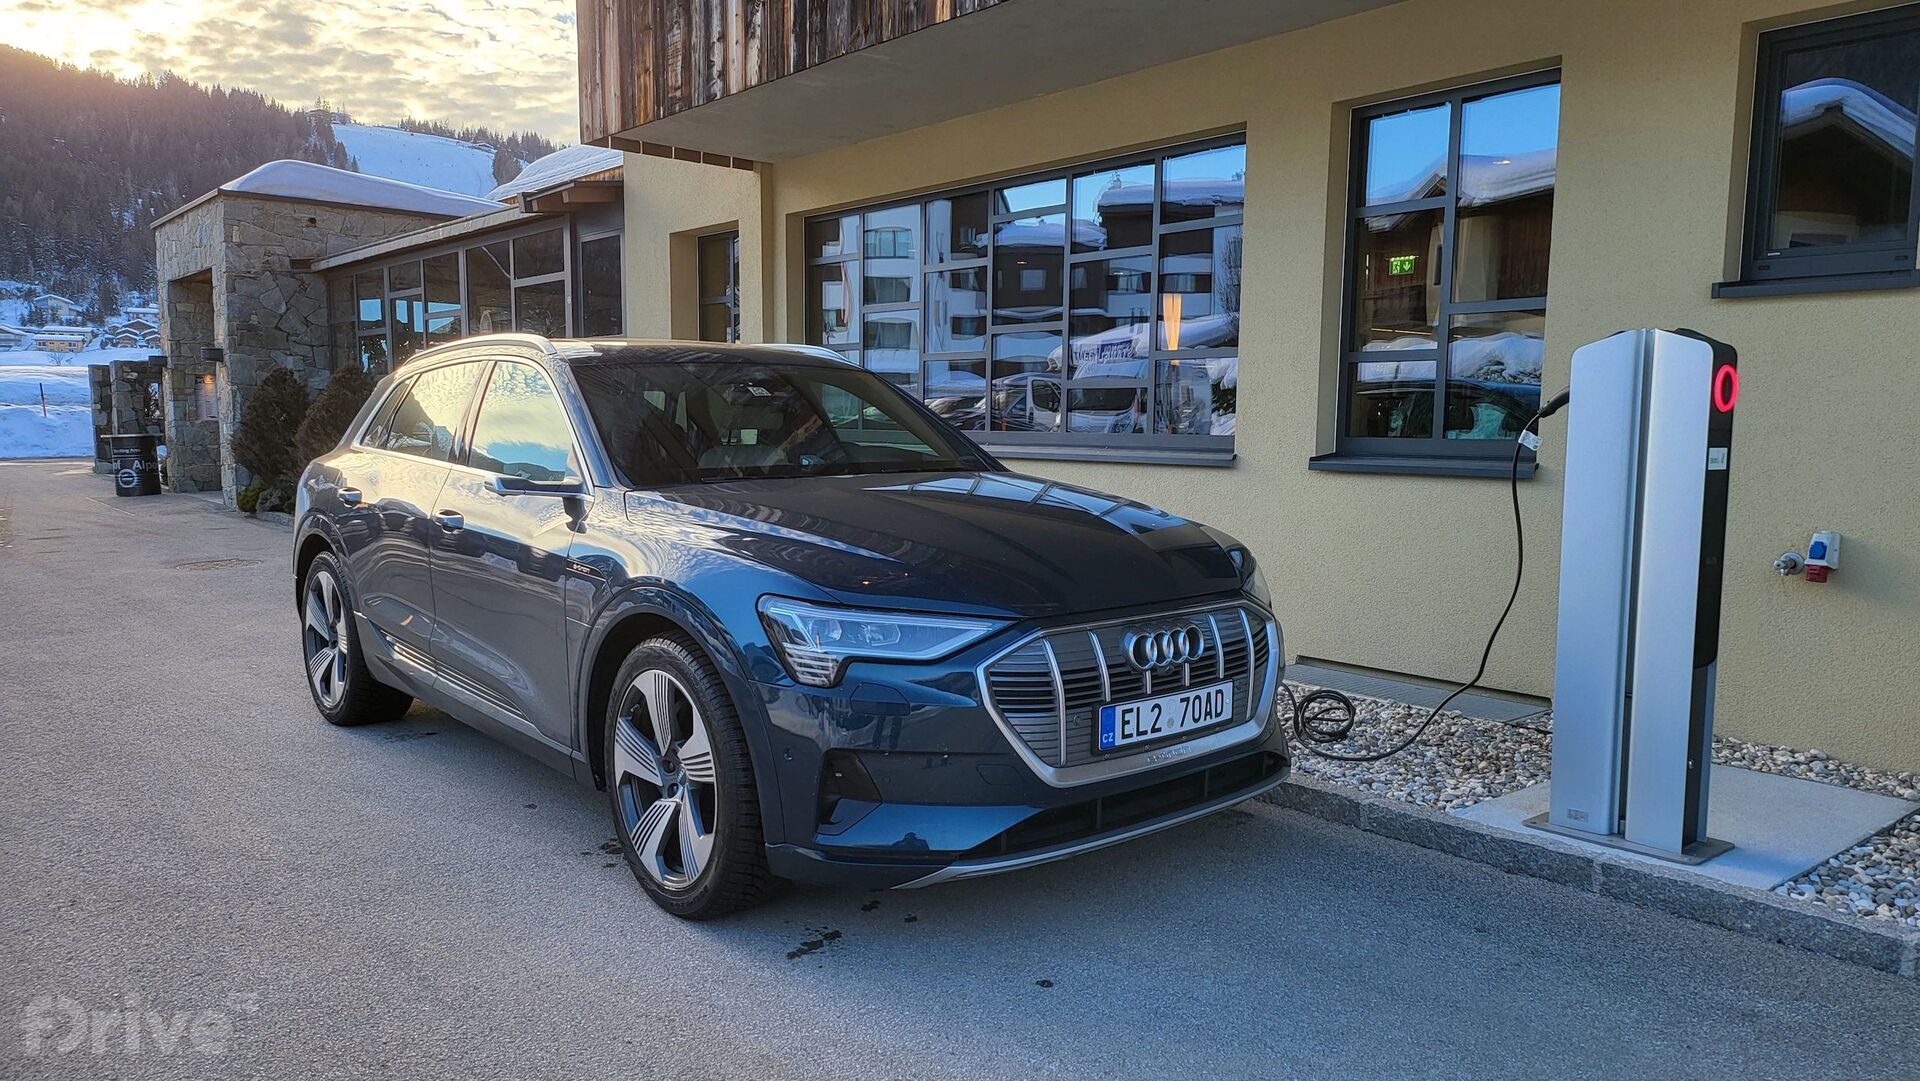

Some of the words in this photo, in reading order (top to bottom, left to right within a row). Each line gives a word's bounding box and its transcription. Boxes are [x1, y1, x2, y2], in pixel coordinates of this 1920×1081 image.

[1121, 703, 1162, 740] EL2
[1179, 688, 1224, 727] 70AD
[1102, 732, 1114, 743] CZ
